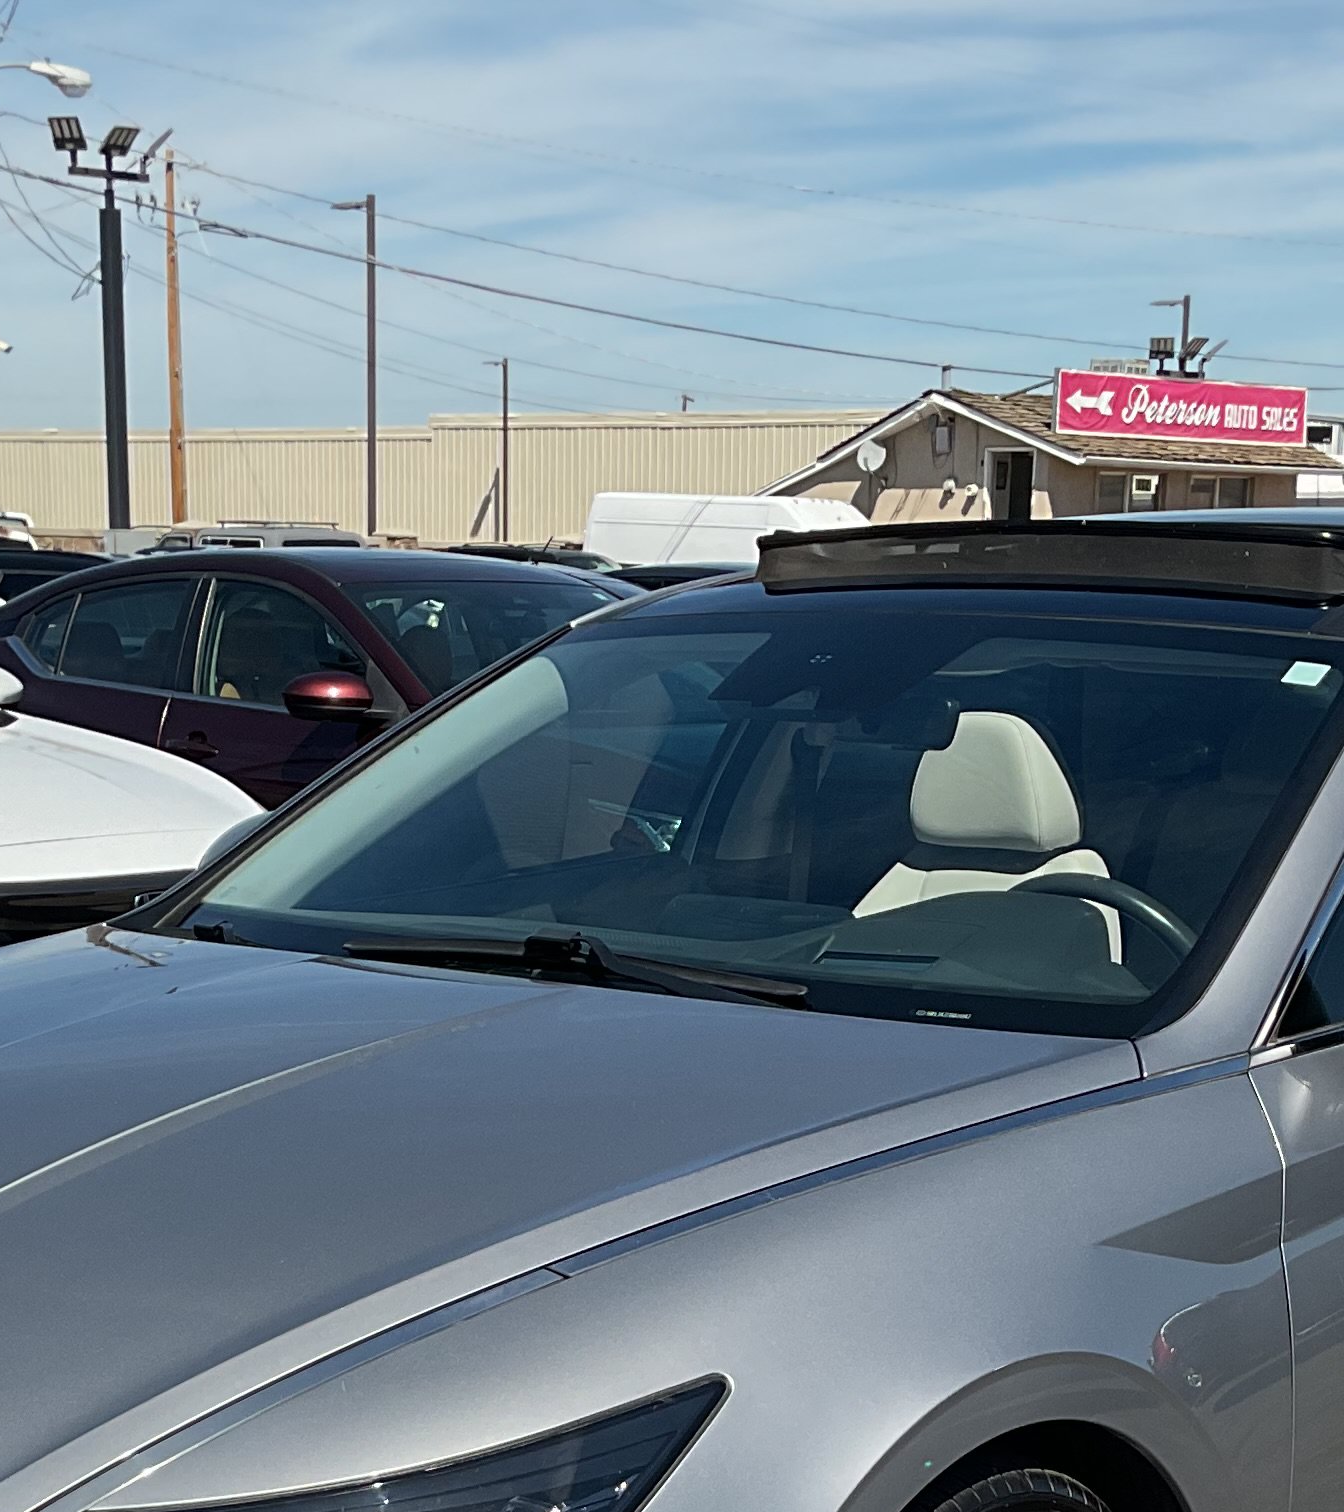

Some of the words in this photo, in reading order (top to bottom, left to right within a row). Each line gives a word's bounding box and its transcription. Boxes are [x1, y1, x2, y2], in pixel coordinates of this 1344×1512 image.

[1121, 384, 1221, 427] Peterson
[1224, 403, 1257, 430] AUTO
[1260, 406, 1299, 432] SALES
